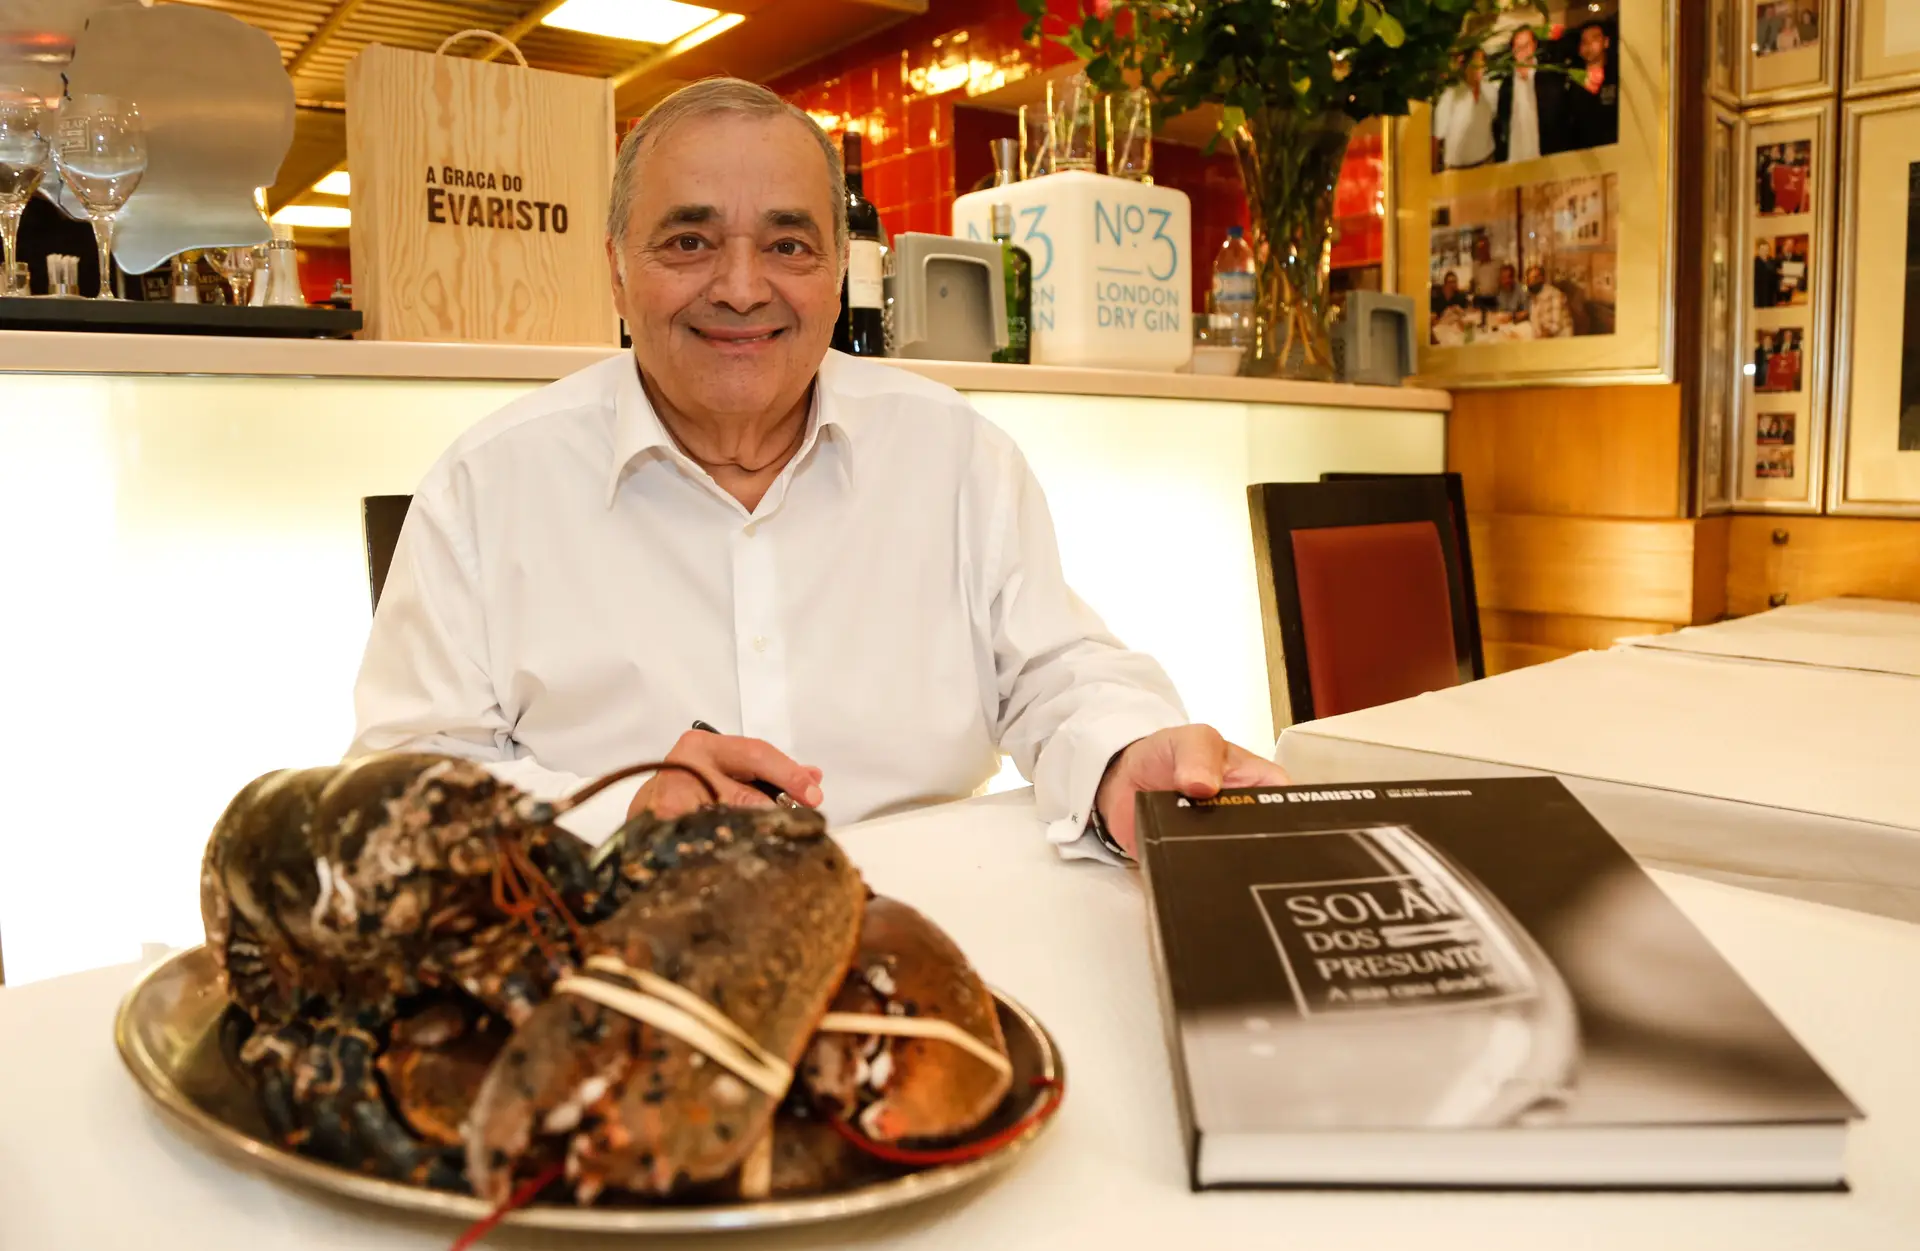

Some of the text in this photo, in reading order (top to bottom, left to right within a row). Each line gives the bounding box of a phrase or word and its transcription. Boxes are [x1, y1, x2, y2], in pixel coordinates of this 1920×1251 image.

[426, 166, 436, 184] A
[502, 174, 522, 192] DO
[427, 187, 568, 234] EVARISTO
[1096, 281, 1179, 307] LONDON
[1098, 304, 1179, 333] DRY GIN
[1177, 797, 1191, 808] A
[1258, 792, 1285, 804] DO
[1286, 788, 1377, 803] EVARISTO
[1303, 927, 1381, 953] DOS
